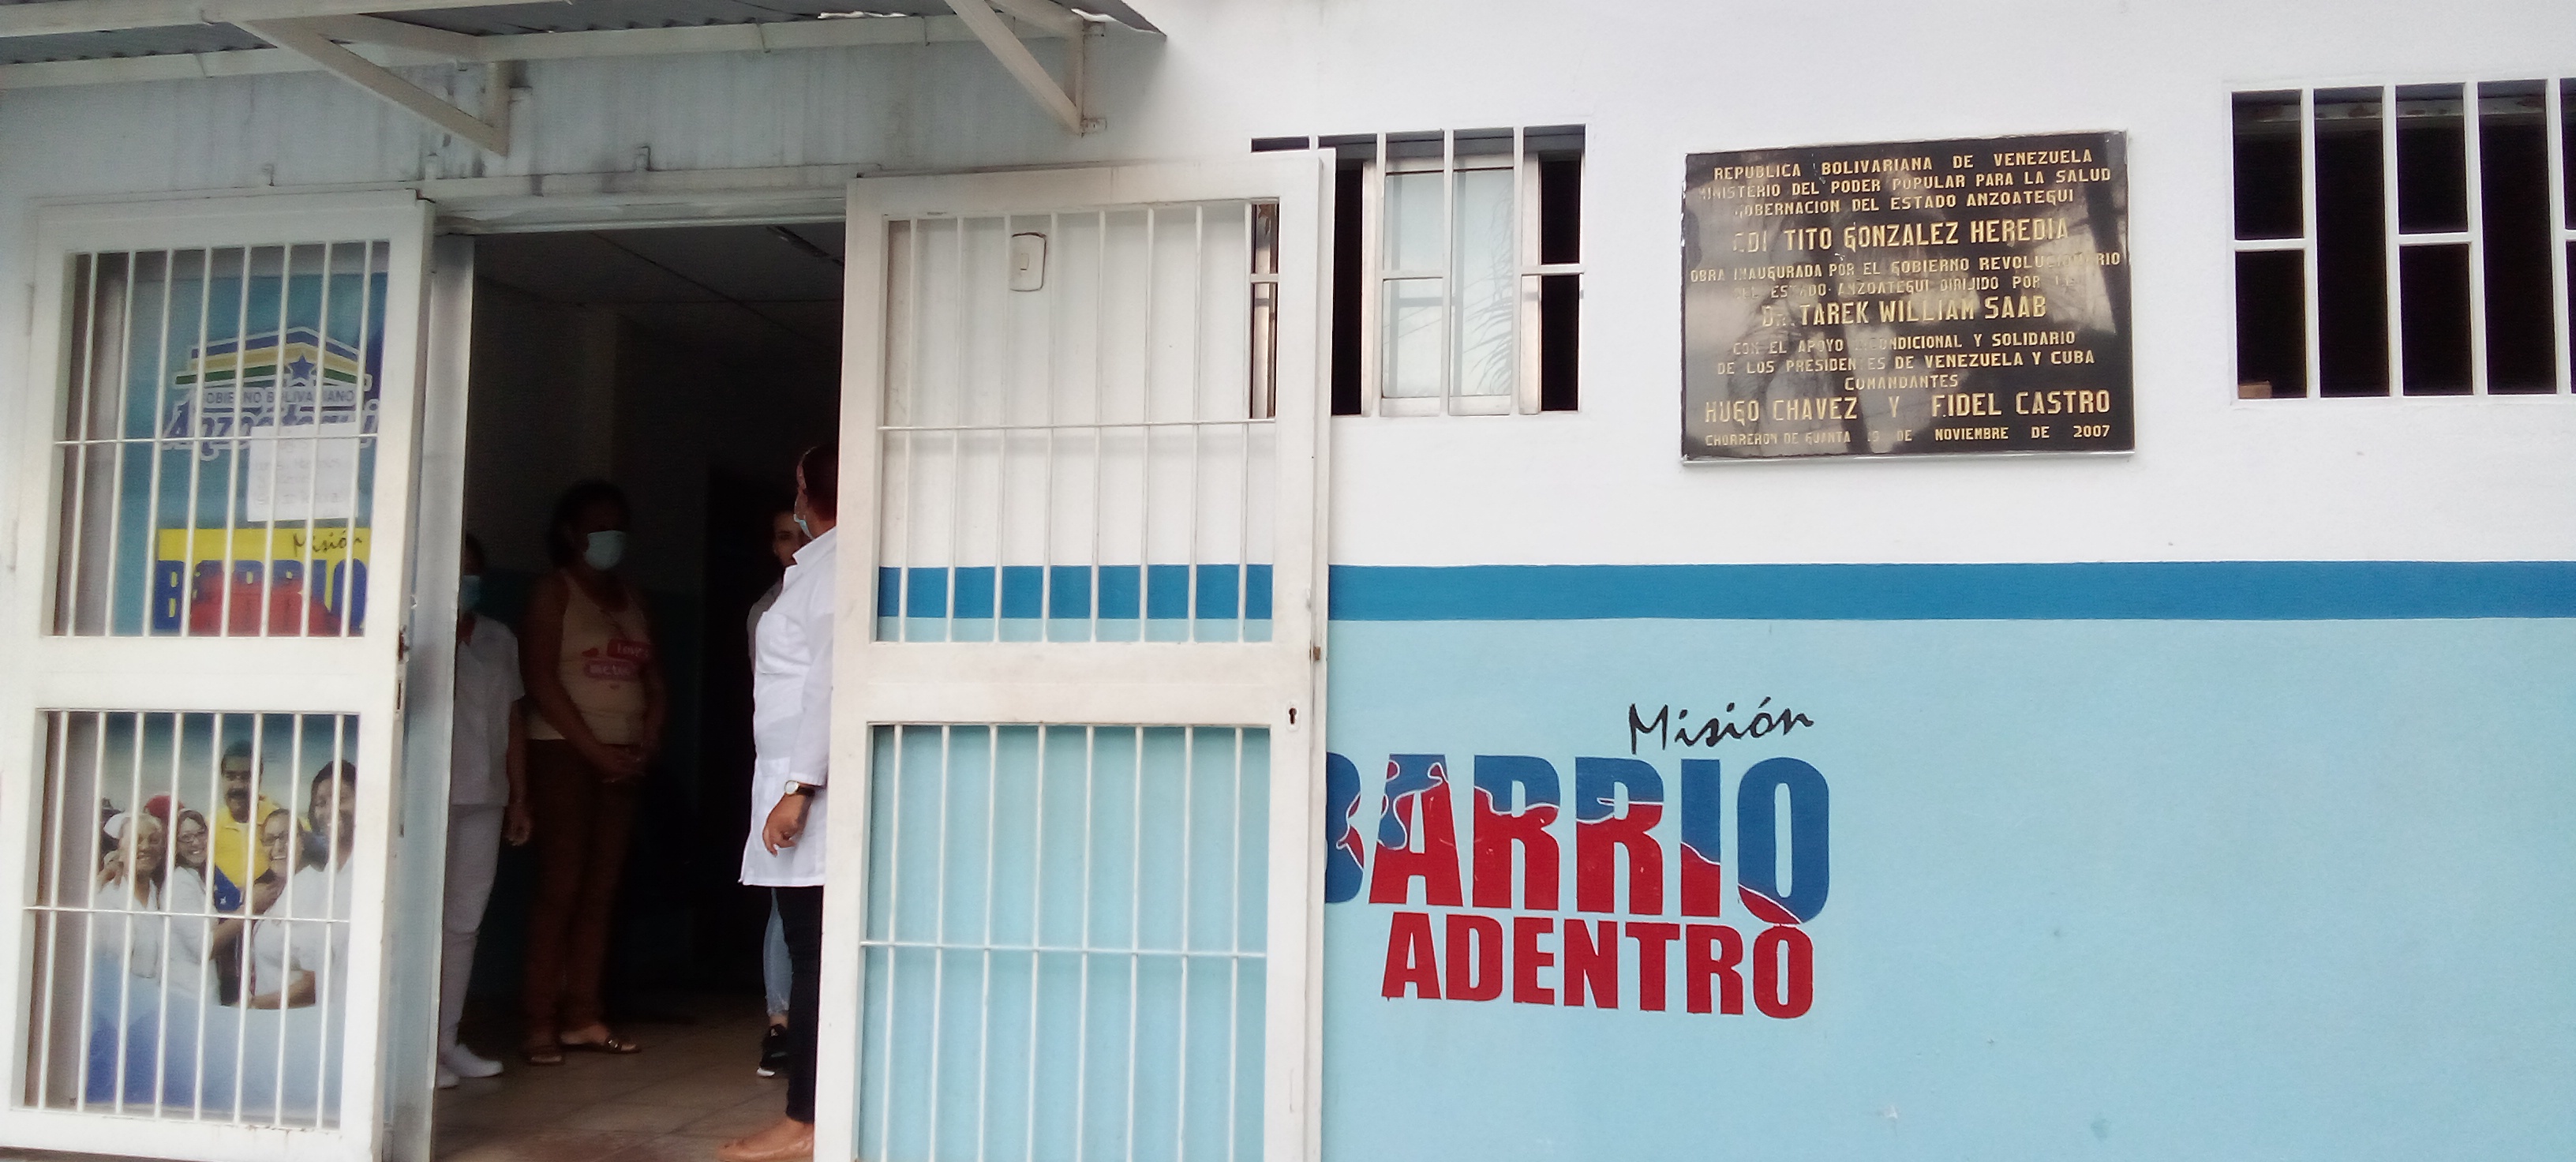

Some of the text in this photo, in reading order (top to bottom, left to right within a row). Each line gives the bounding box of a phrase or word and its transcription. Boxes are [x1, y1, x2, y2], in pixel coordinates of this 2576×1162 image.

[1714, 149, 2092, 181] REPUBLICA BOLIVARIANA DE VENEZUELA
[1700, 168, 2111, 200] MINISTERIO DEL PODER POPULAR PARA LA SALUD
[1735, 189, 2074, 219] GOBERNACION DEL ESTADO ANZOATEGUI
[1733, 217, 2069, 253] CDI TITO GONZALEZ HEREDIA
[1690, 269, 1724, 283] OBRA
[1734, 264, 1822, 282] INAUGURADA
[1829, 263, 1854, 276] POR
[1863, 262, 1880, 275] EL
[1891, 257, 1970, 277] GOBIERNO
[1941, 277, 1999, 290] DIRIJIDO
[2012, 276, 2040, 289] POR
[1799, 302, 1869, 326] TAREK
[1879, 300, 1974, 323] WILLIAM
[1985, 295, 2046, 319] SAAB
[1769, 342, 1787, 354] EL
[1799, 339, 1844, 353] APOYO
[1974, 334, 1982, 347] Y
[1992, 331, 2075, 347] SOLIDARIO
[1718, 362, 1735, 375] DE
[1747, 361, 1775, 374] LOS
[1895, 356, 1914, 369] DE
[1925, 352, 2024, 369] VENEZUELA
[2032, 352, 2041, 365] Y
[2051, 350, 2095, 364] CUBA
[199, 389, 355, 405] OBIENO BLIVAIANO
[1844, 374, 1958, 391] COMANDANTES
[1705, 390, 2110, 425] HUGO CHAVEZ Y FIDEL CASTRO
[1784, 433, 1799, 443] DE
[1806, 431, 1851, 445] GUANTA
[1896, 430, 1912, 441] DE
[1935, 427, 2009, 440] NOVIEMBRE
[2031, 426, 2050, 439] DE
[2073, 425, 2110, 438] 2007
[1628, 697, 1814, 755] Misión
[1381, 911, 1814, 1019] ADENTRO
